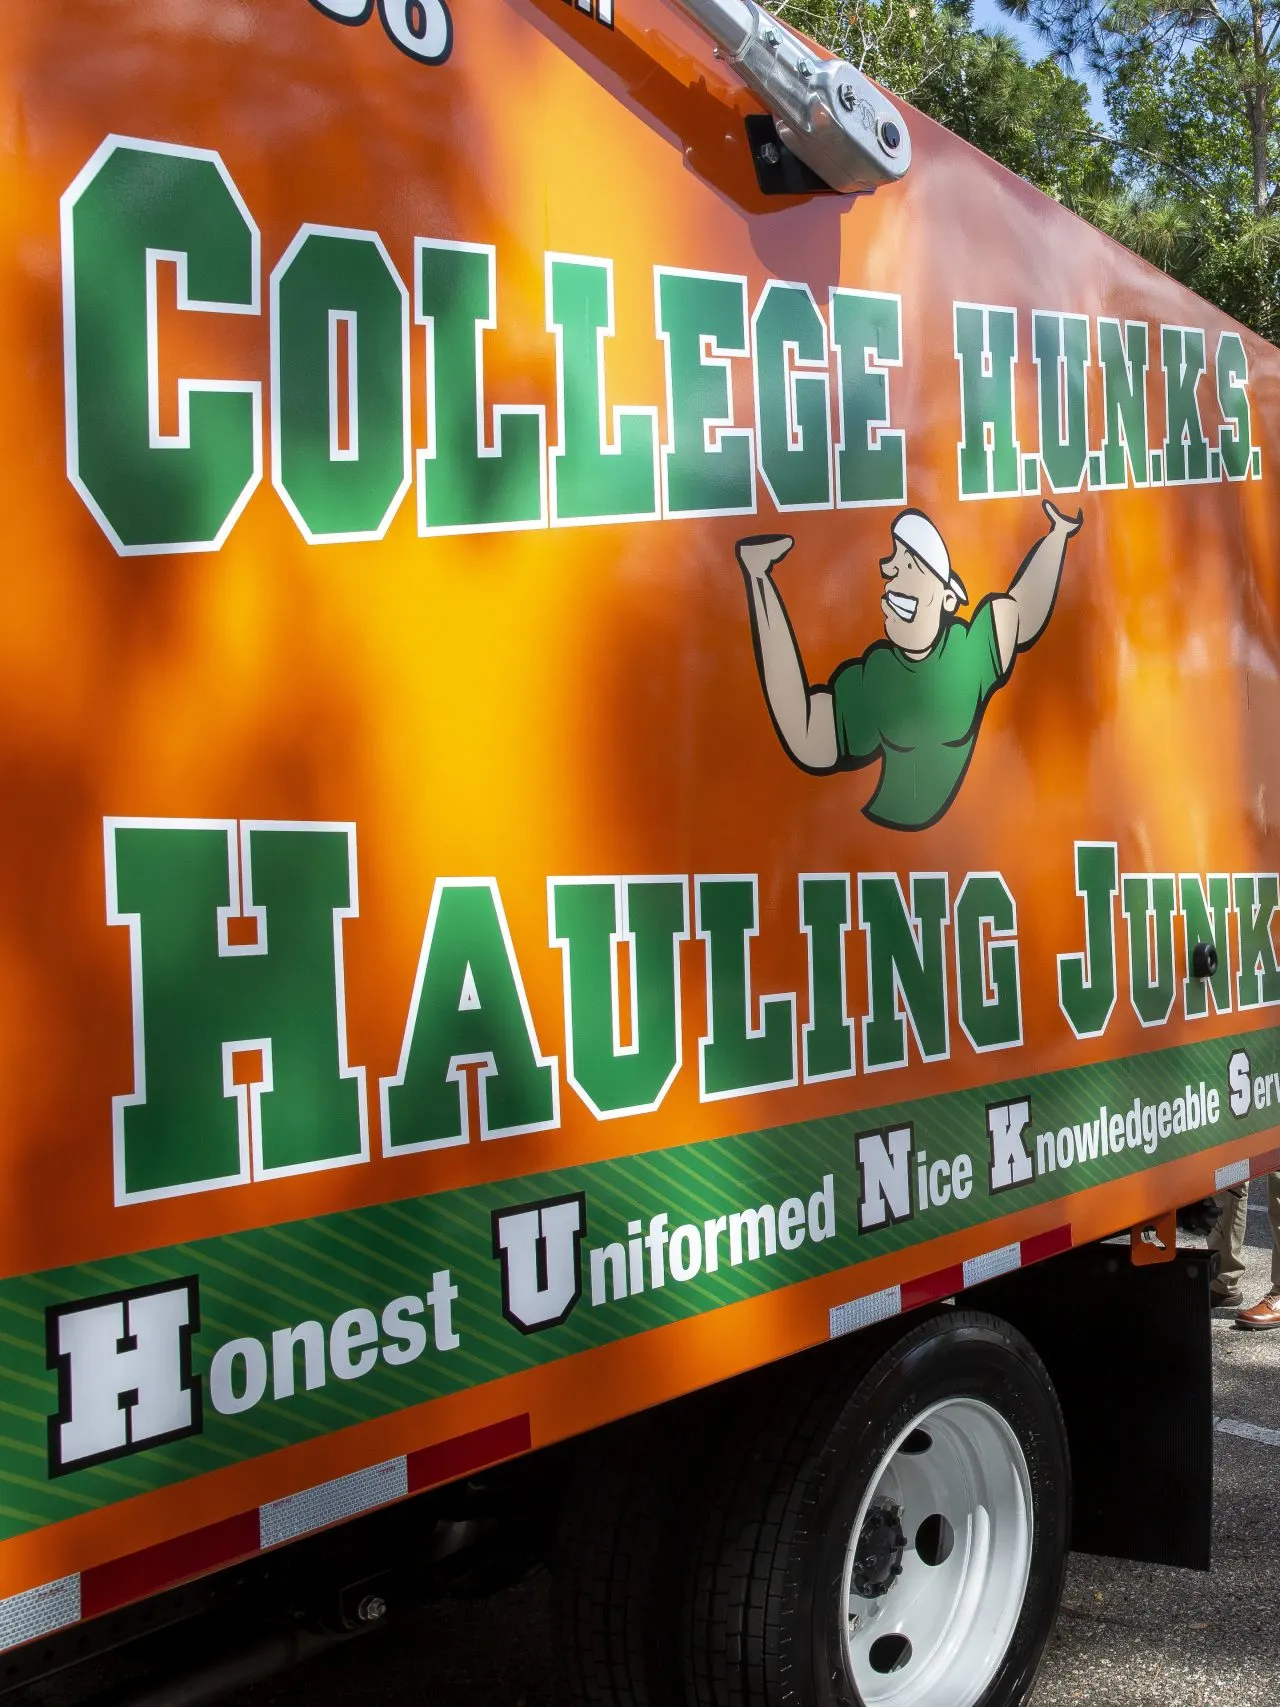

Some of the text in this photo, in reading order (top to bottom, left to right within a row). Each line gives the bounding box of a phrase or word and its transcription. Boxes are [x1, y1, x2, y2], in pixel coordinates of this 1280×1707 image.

[60, 133, 1262, 557] COLLEGE H.U.N.K.S.
[103, 816, 1024, 1208] HAULING
[45, 1273, 460, 1479] Honest
[491, 1191, 836, 1335] Uniformed
[855, 1121, 973, 1235] Nice
[985, 1096, 1220, 1195] Knowledgeable
